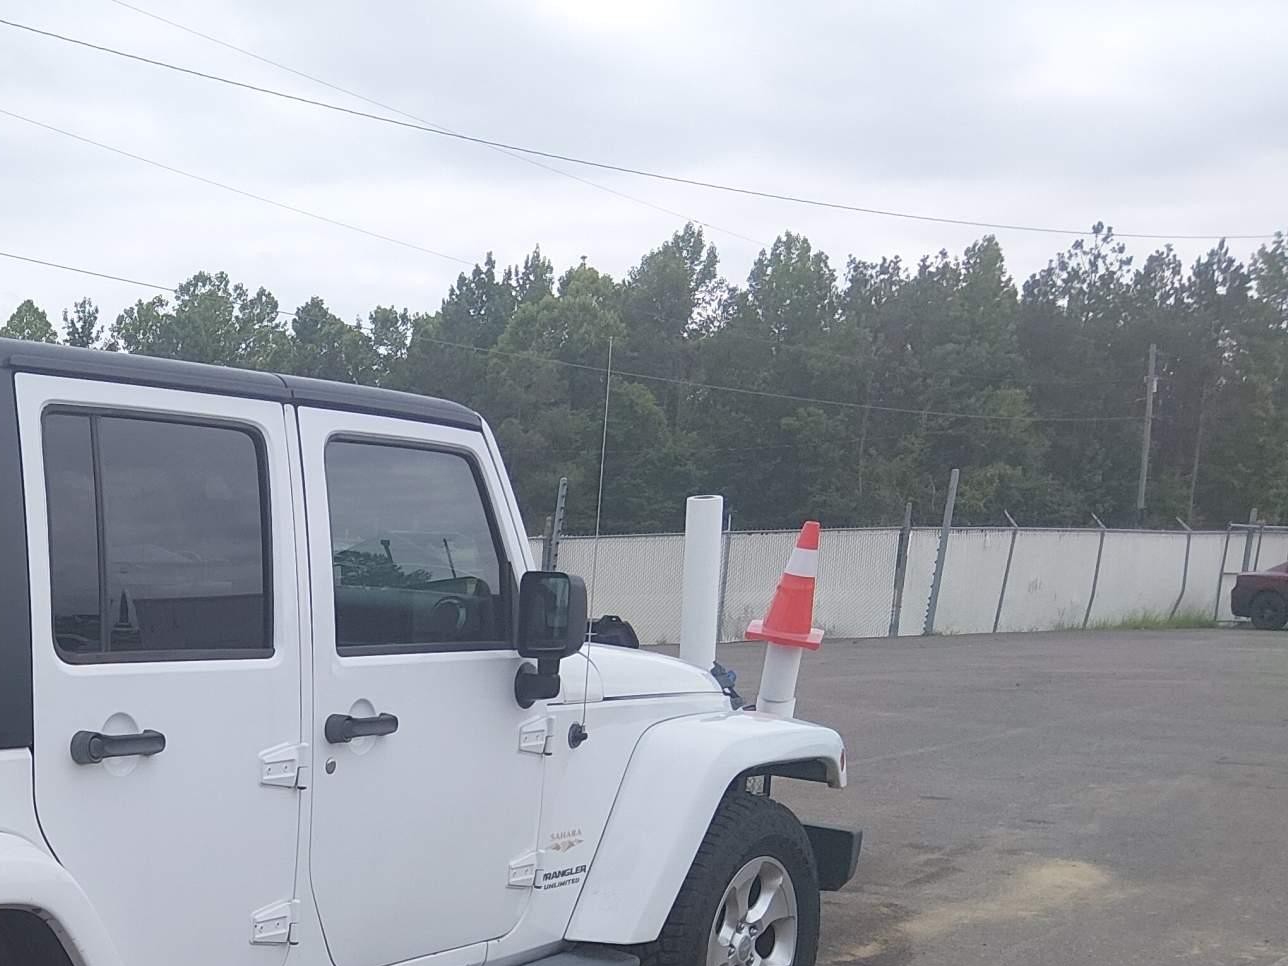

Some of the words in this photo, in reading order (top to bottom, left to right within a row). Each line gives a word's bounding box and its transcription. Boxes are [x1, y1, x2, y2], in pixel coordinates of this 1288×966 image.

[550, 829, 582, 839] SAHARA
[543, 864, 586, 881] RANGLER
[543, 877, 580, 891] UNLIMITED
